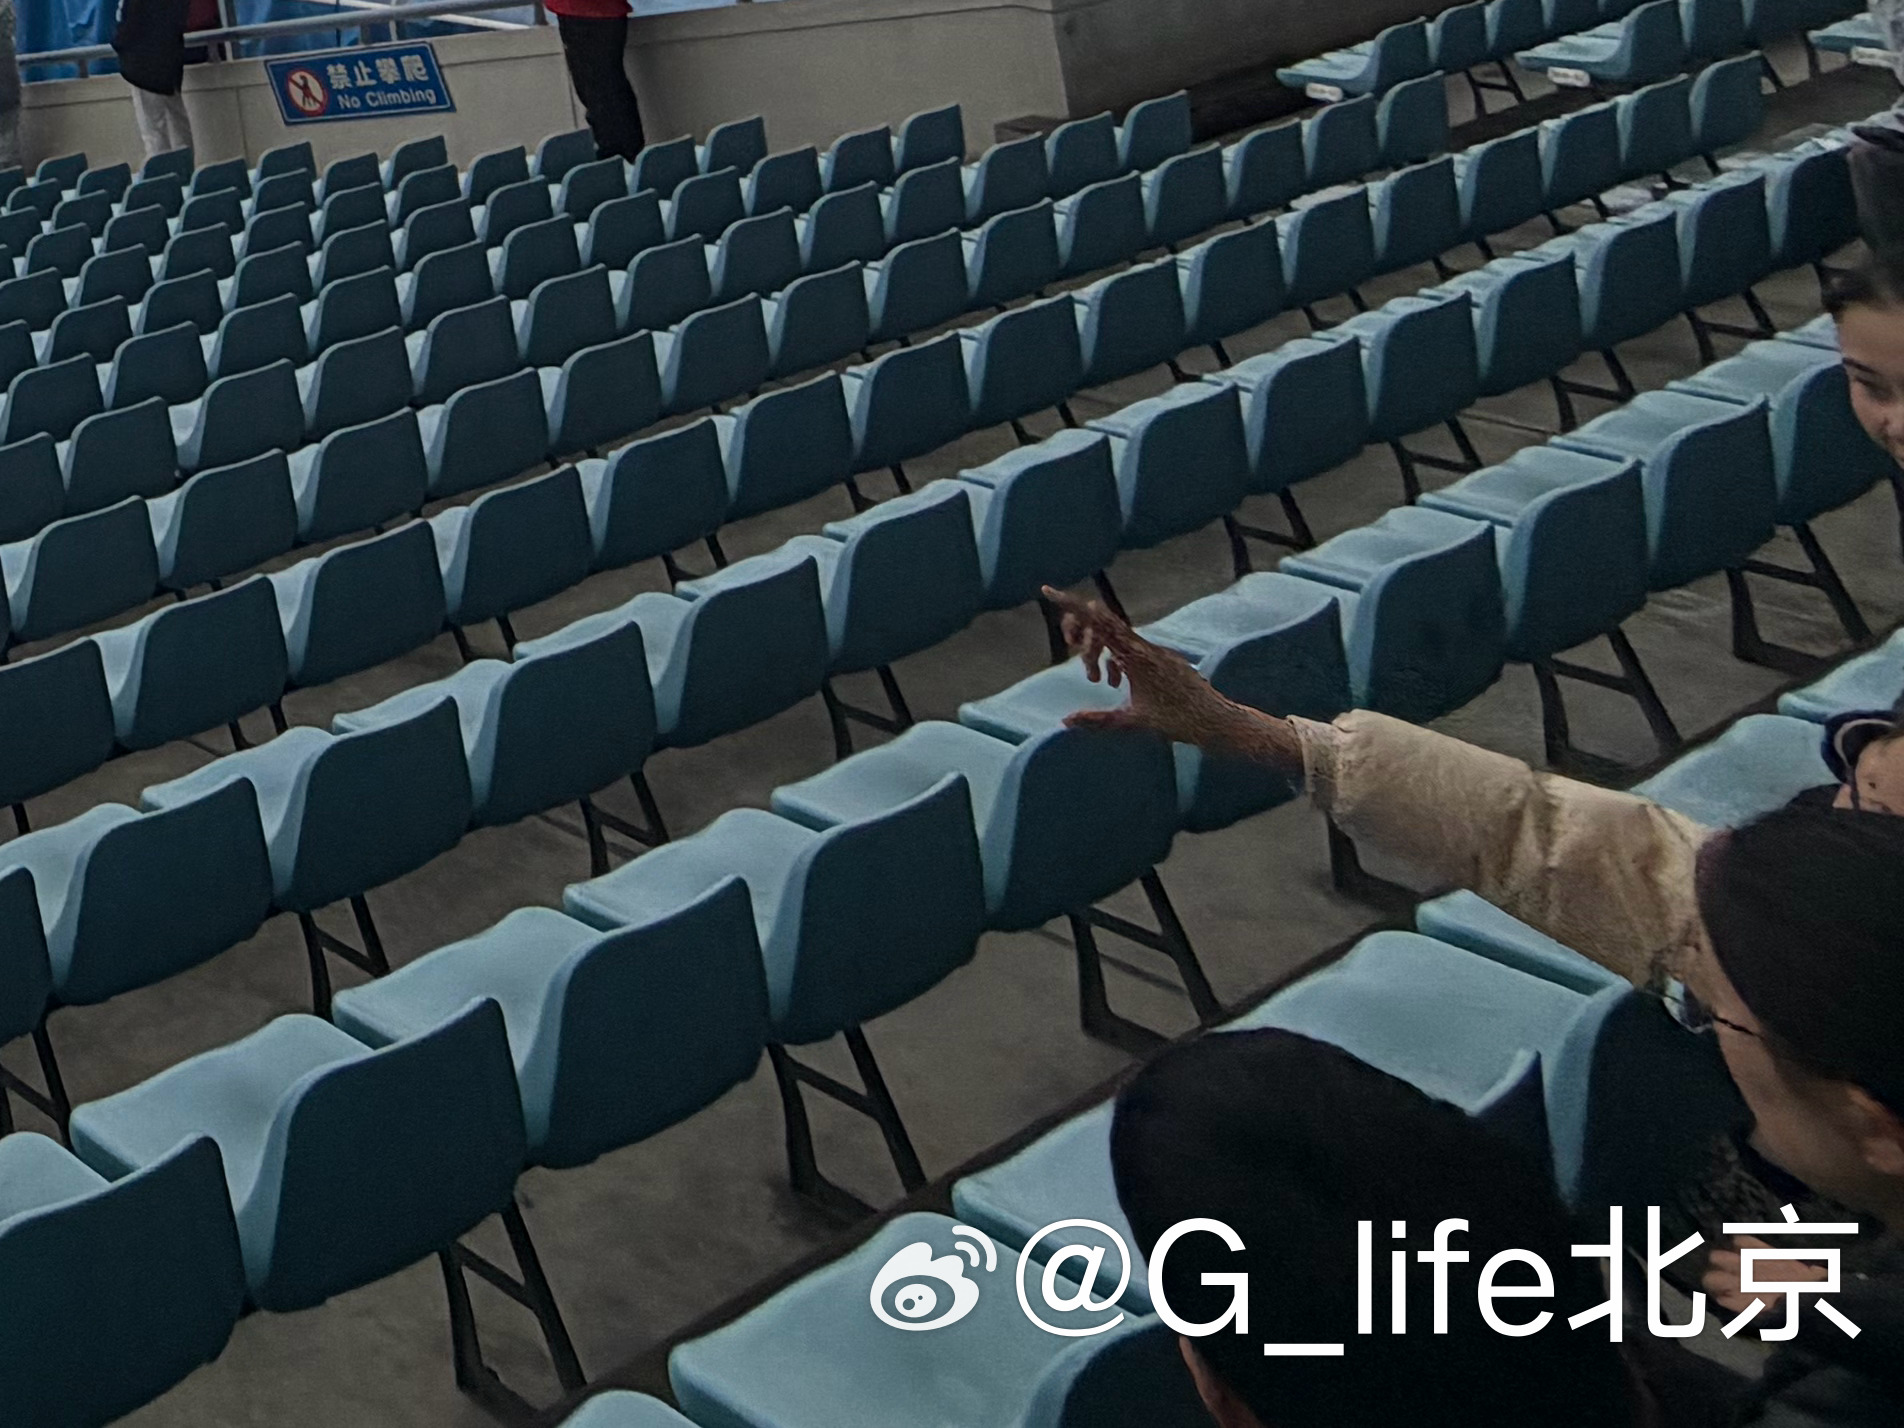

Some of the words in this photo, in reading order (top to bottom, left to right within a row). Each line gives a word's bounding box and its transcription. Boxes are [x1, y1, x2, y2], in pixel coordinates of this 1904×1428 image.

[326, 54, 429, 89] 禁止攀爬
[337, 94, 361, 109] No
[366, 88, 437, 108] Climbing
